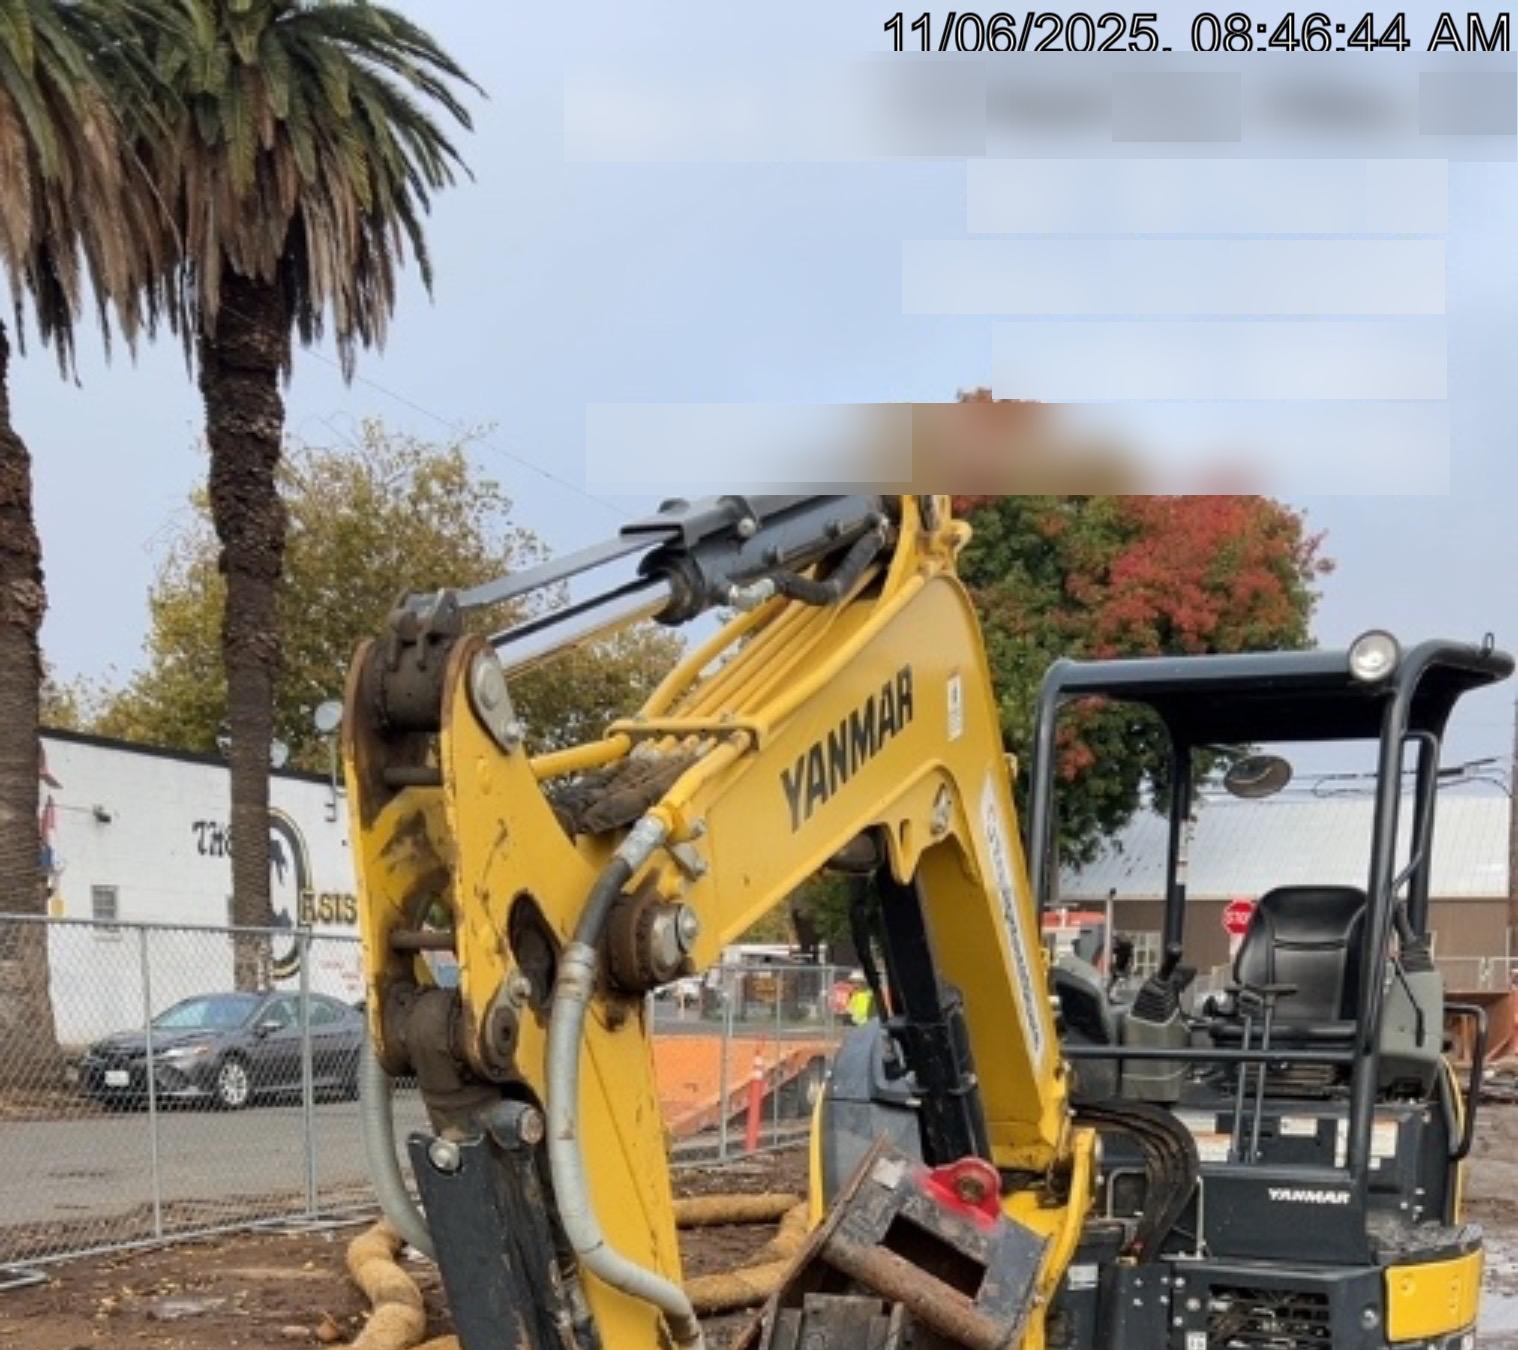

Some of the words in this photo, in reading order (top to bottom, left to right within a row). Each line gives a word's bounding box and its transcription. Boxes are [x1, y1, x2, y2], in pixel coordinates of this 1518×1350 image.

[779, 662, 914, 834] YANMAR
[1224, 910, 1250, 925] STO
[1268, 1186, 1352, 1205] YANMAR
